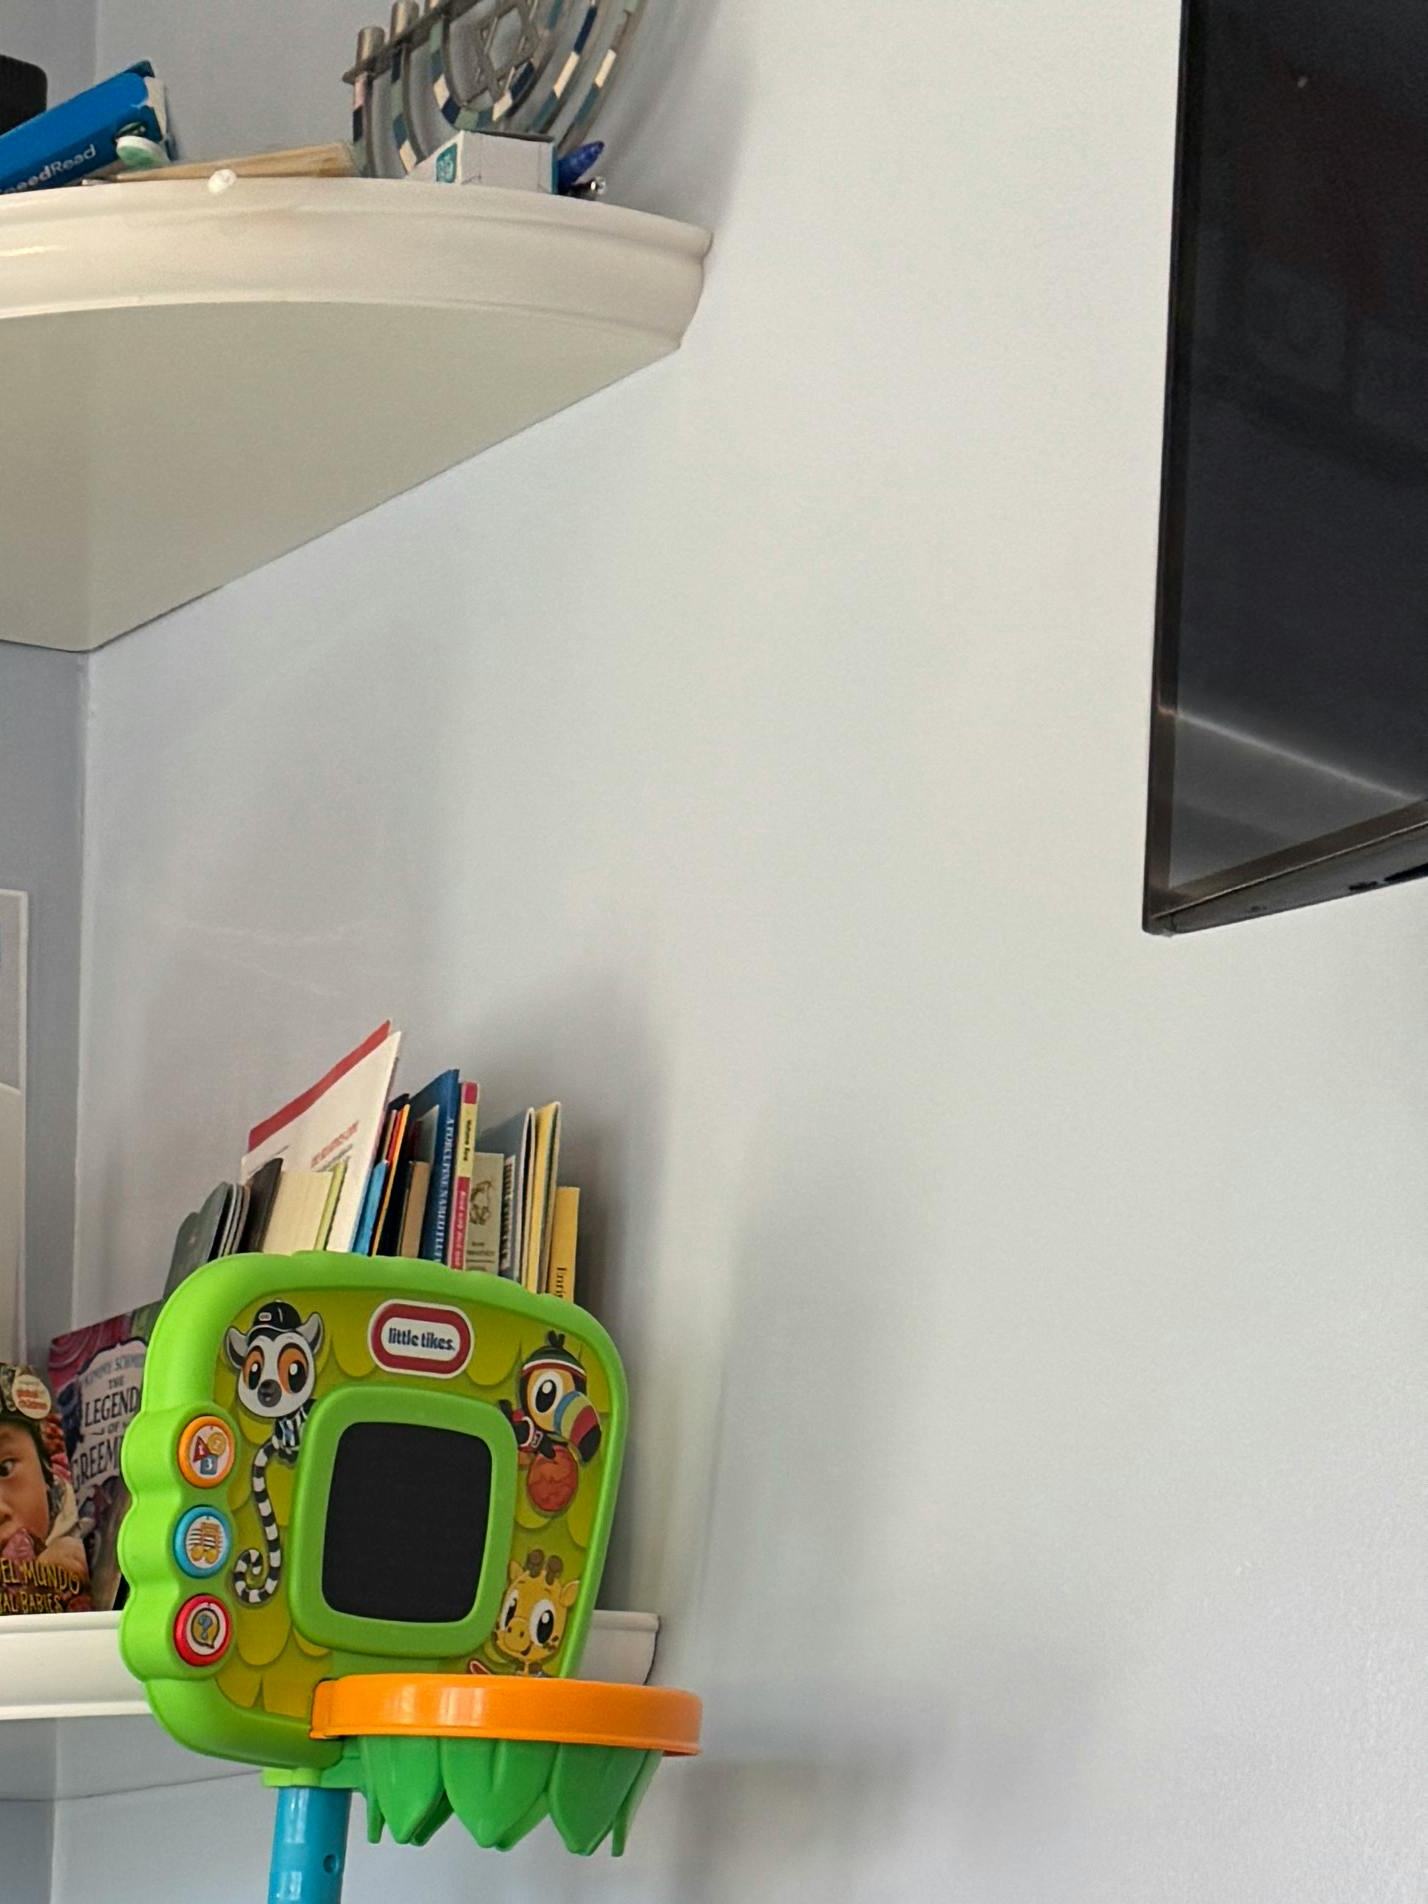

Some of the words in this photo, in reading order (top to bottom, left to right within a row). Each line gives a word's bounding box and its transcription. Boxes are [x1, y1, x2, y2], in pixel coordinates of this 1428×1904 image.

[387, 1327, 419, 1349] little
[83, 1386, 141, 1428] LEGEND
[204, 1457, 214, 1470] 3
[20, 1564, 82, 1595] MUNDO
[19, 1592, 64, 1613] BABIES
